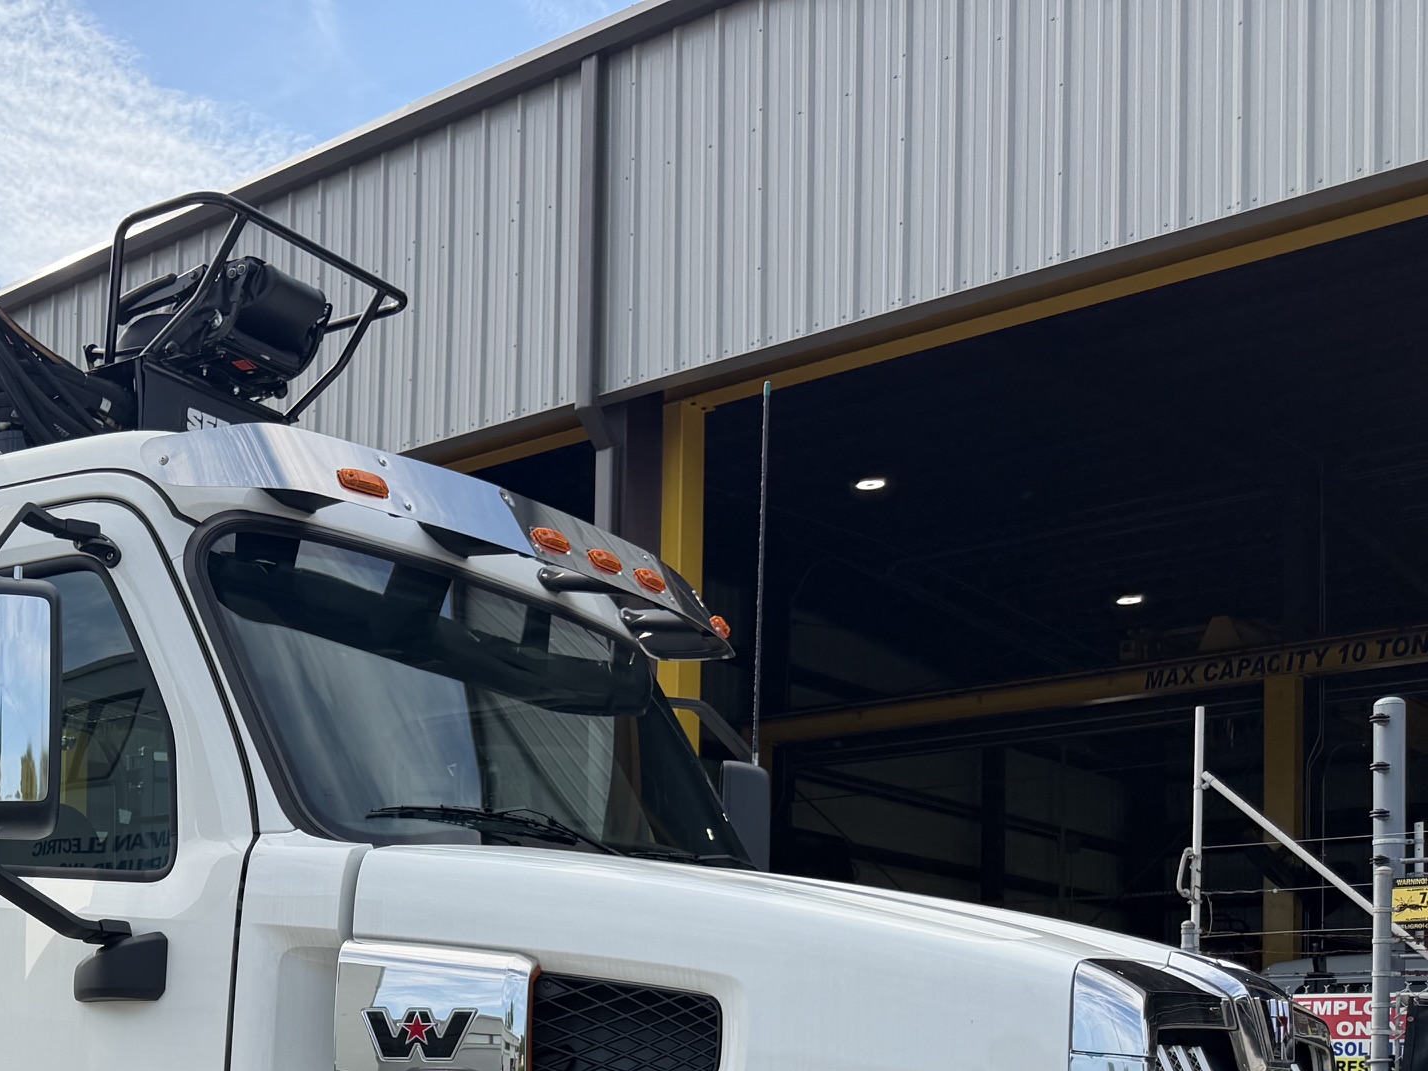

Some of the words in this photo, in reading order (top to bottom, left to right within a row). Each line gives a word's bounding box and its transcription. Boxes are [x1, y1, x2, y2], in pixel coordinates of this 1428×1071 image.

[1144, 664, 1197, 690] MAX
[1203, 647, 1329, 682] CAPACITY
[1338, 641, 1367, 665] 10
